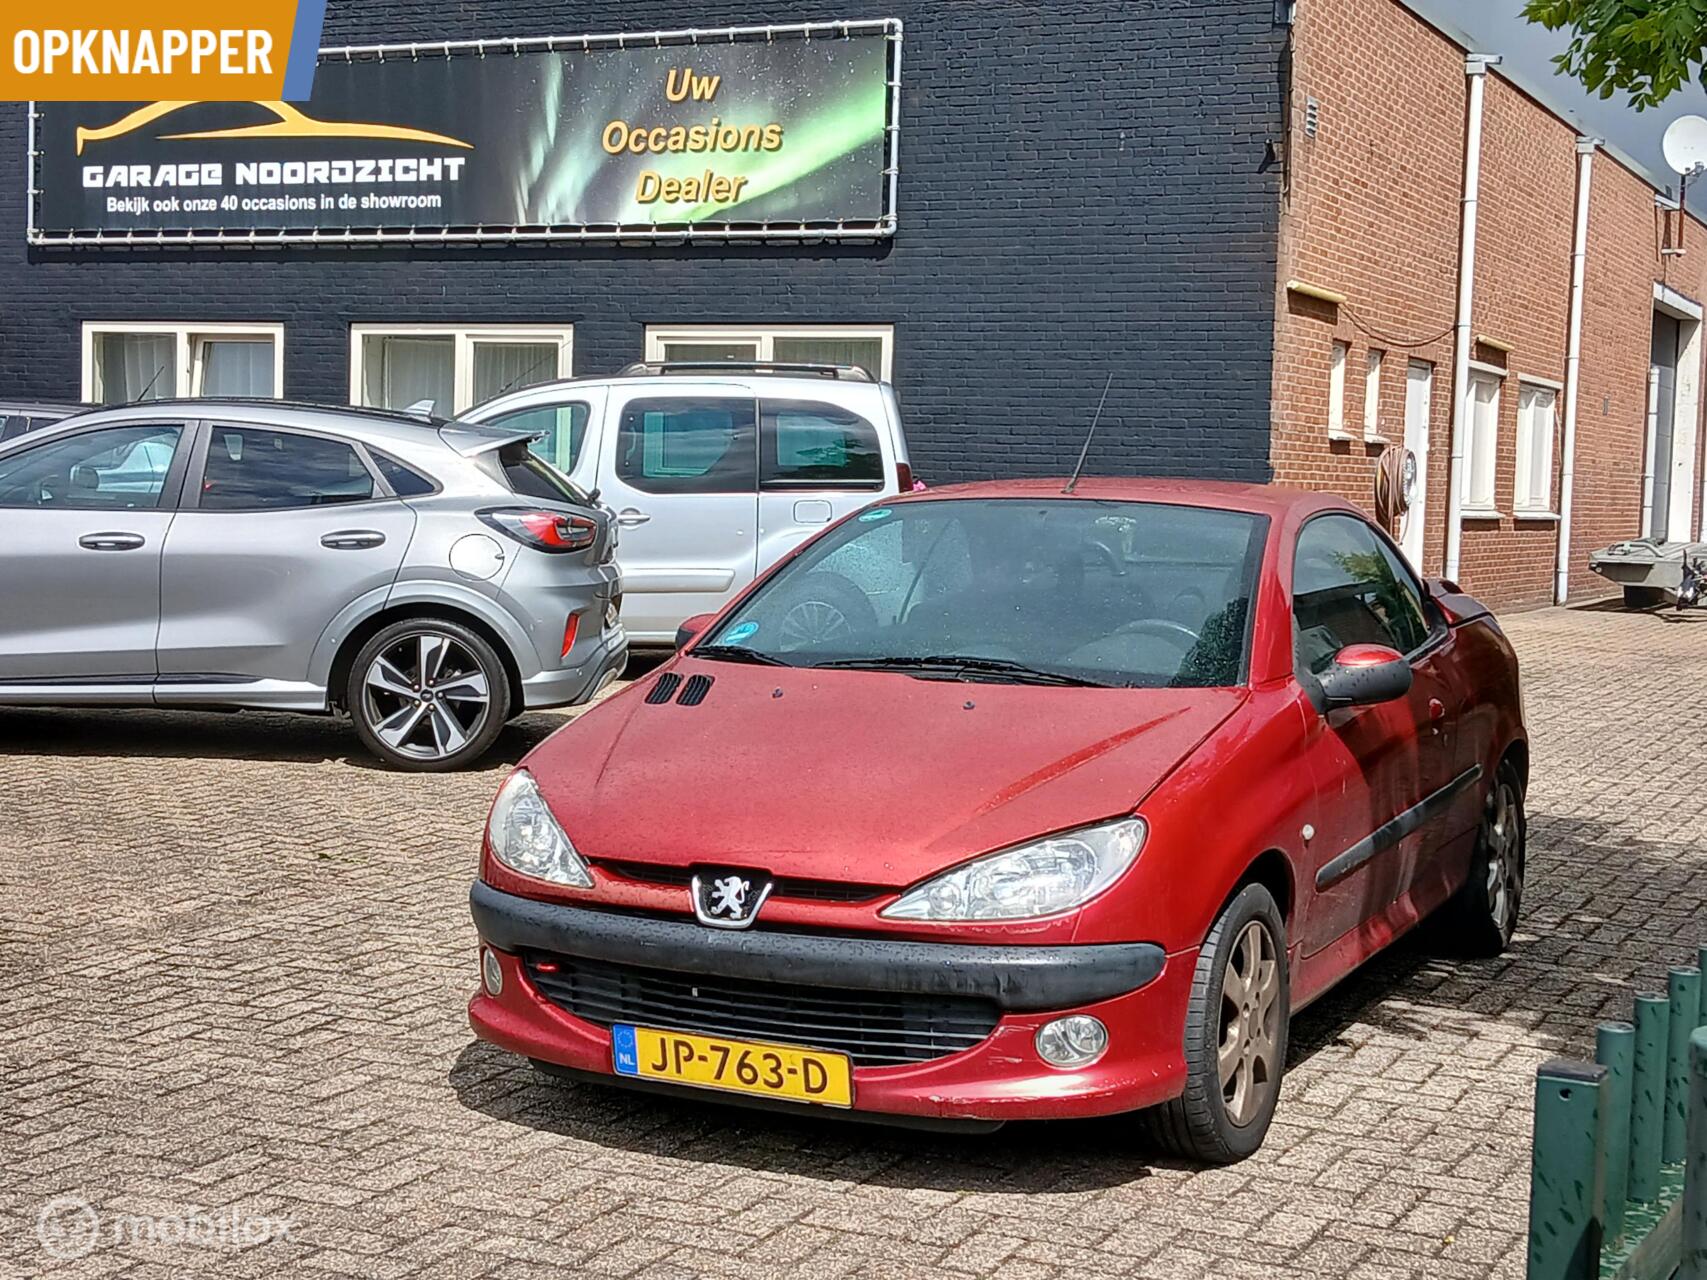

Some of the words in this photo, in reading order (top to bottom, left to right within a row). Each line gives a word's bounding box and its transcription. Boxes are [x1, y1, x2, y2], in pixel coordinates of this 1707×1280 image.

[665, 68, 720, 101] Uw
[602, 117, 783, 154] Occasions
[82, 163, 223, 188] GARAGE
[235, 157, 465, 185] NOORDZICHT
[635, 169, 748, 203] Dealer
[106, 196, 150, 216] Bekijk
[153, 196, 180, 212] ook
[183, 199, 217, 212] onze
[220, 194, 238, 211] 40
[241, 194, 317, 211] occasions
[320, 193, 334, 210] in
[338, 193, 357, 210] de
[360, 192, 442, 209] showroom
[619, 1052, 635, 1067] NL
[651, 1037, 828, 1094] JP-763-D
